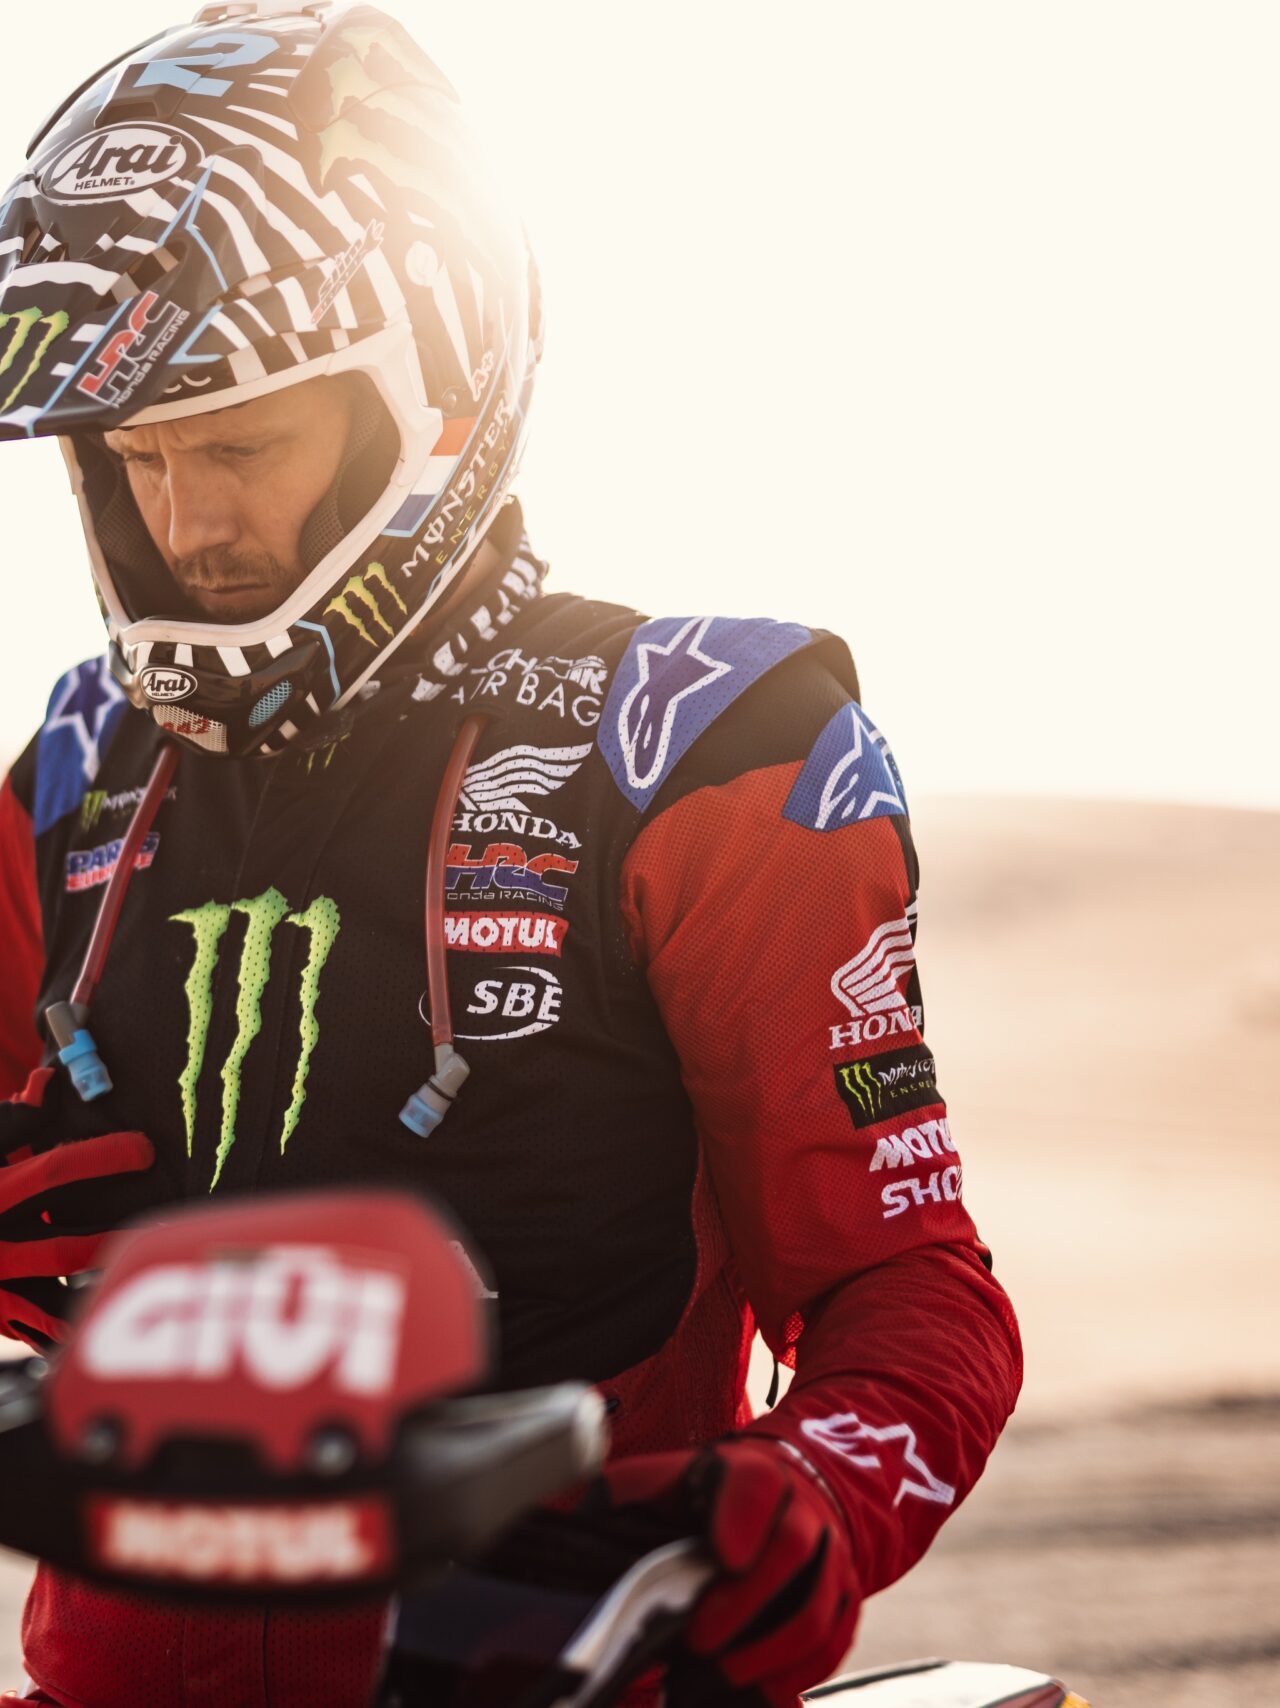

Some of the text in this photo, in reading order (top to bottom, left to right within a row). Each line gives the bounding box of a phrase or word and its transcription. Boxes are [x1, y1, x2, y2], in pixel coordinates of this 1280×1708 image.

[47, 134, 183, 180] Arai
[74, 176, 132, 192] HELMET
[77, 290, 181, 405] HRC
[148, 310, 191, 363] RACING
[435, 440, 510, 566] ENERGY
[146, 672, 188, 692] Arai
[516, 672, 601, 727] BAG
[450, 811, 583, 850] HONDA
[445, 843, 580, 902] HRC
[446, 889, 565, 911] onda RACING
[444, 917, 559, 949] MOTUL
[829, 1004, 924, 1050] HONA
[869, 1117, 958, 1173] MOTU
[106, 1505, 375, 1580] MOTUL
